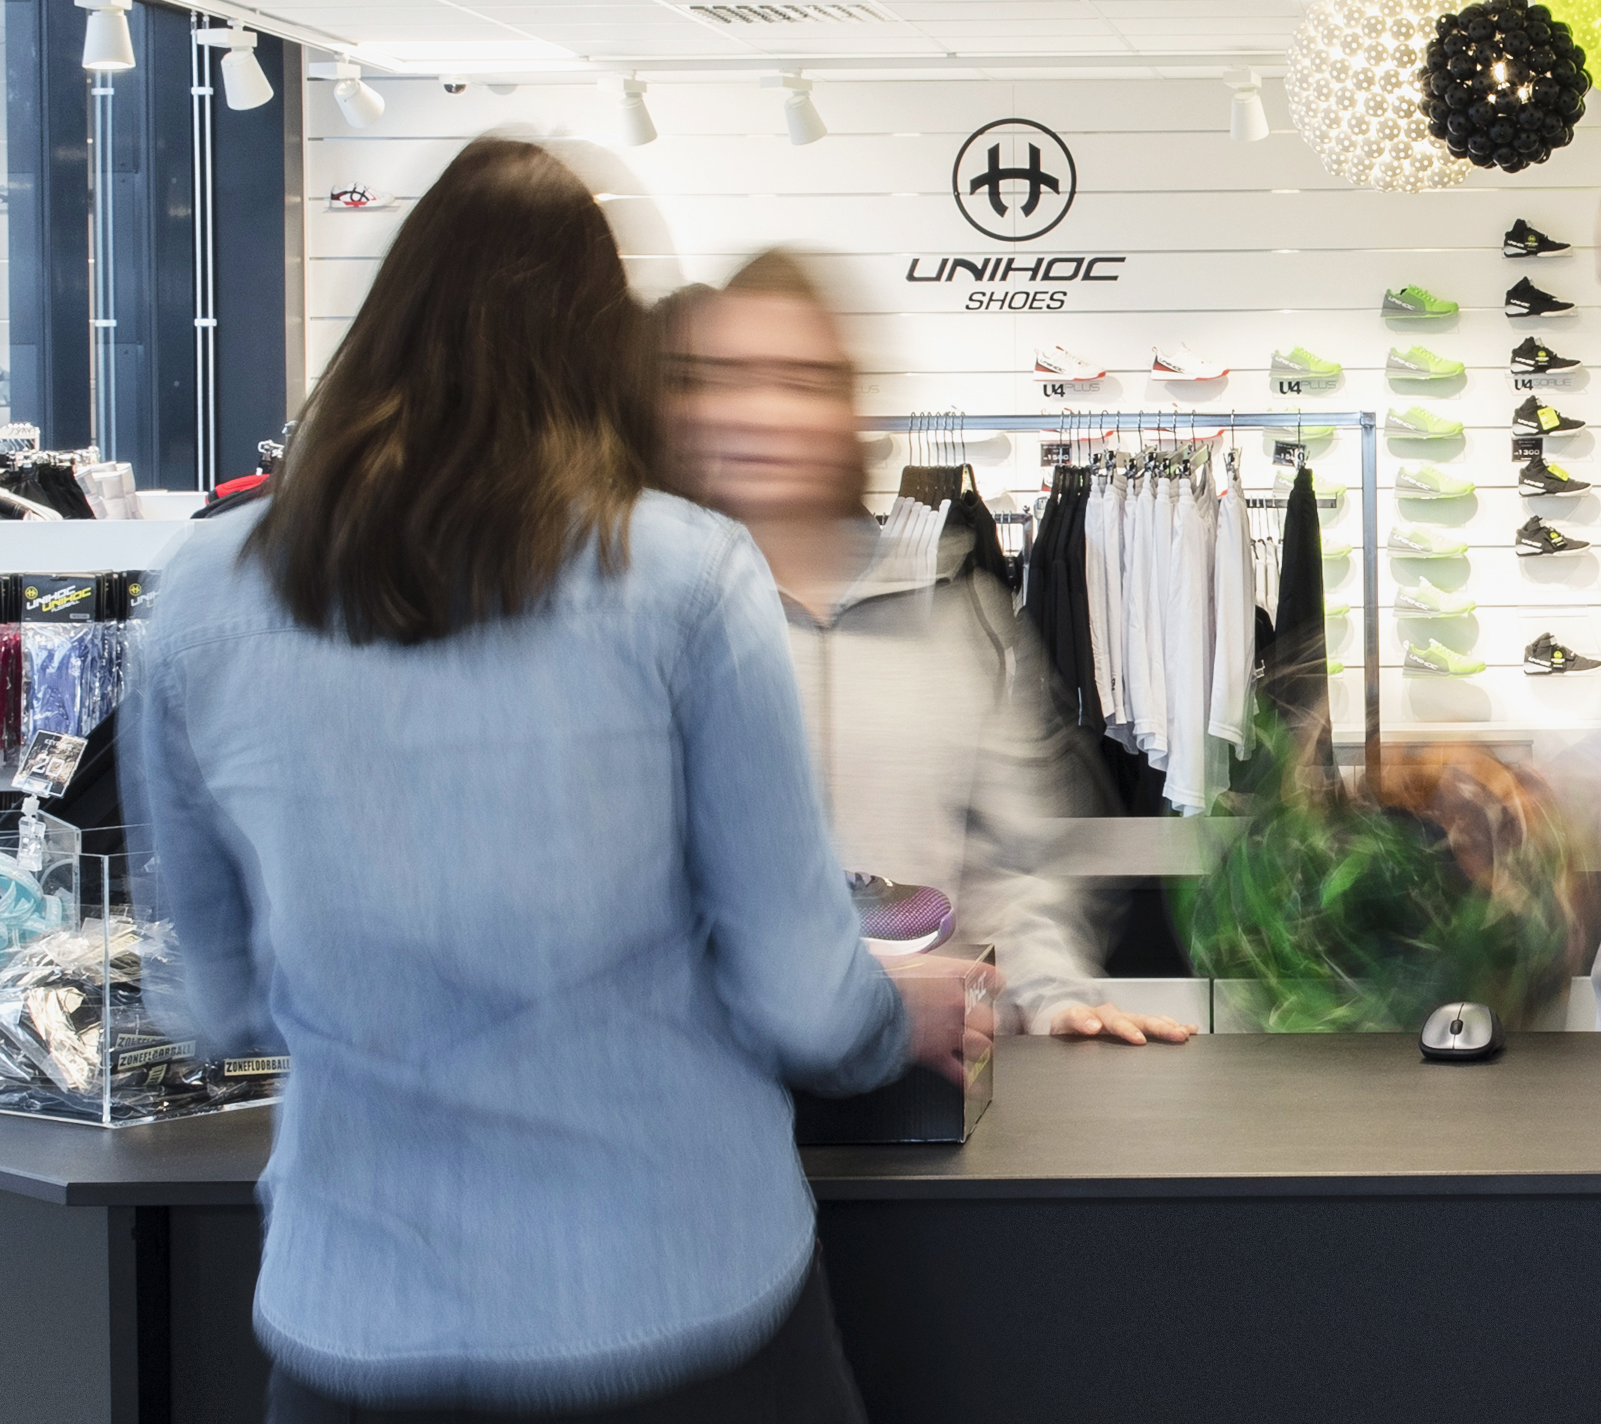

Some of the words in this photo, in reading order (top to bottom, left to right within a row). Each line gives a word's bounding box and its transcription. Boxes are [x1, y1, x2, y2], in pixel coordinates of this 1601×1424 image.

[905, 257, 1127, 282] UNIHOC
[965, 290, 1068, 310] SHOES
[1388, 295, 1416, 311] UNIHOC
[1043, 384, 1065, 397] U4
[1065, 381, 1101, 392] PLUS
[1279, 381, 1302, 394] U4
[1301, 379, 1337, 390] PLUS
[1514, 379, 1533, 390] U4
[26, 584, 76, 611] UNIHOC
[42, 587, 92, 612] UNIHOC
